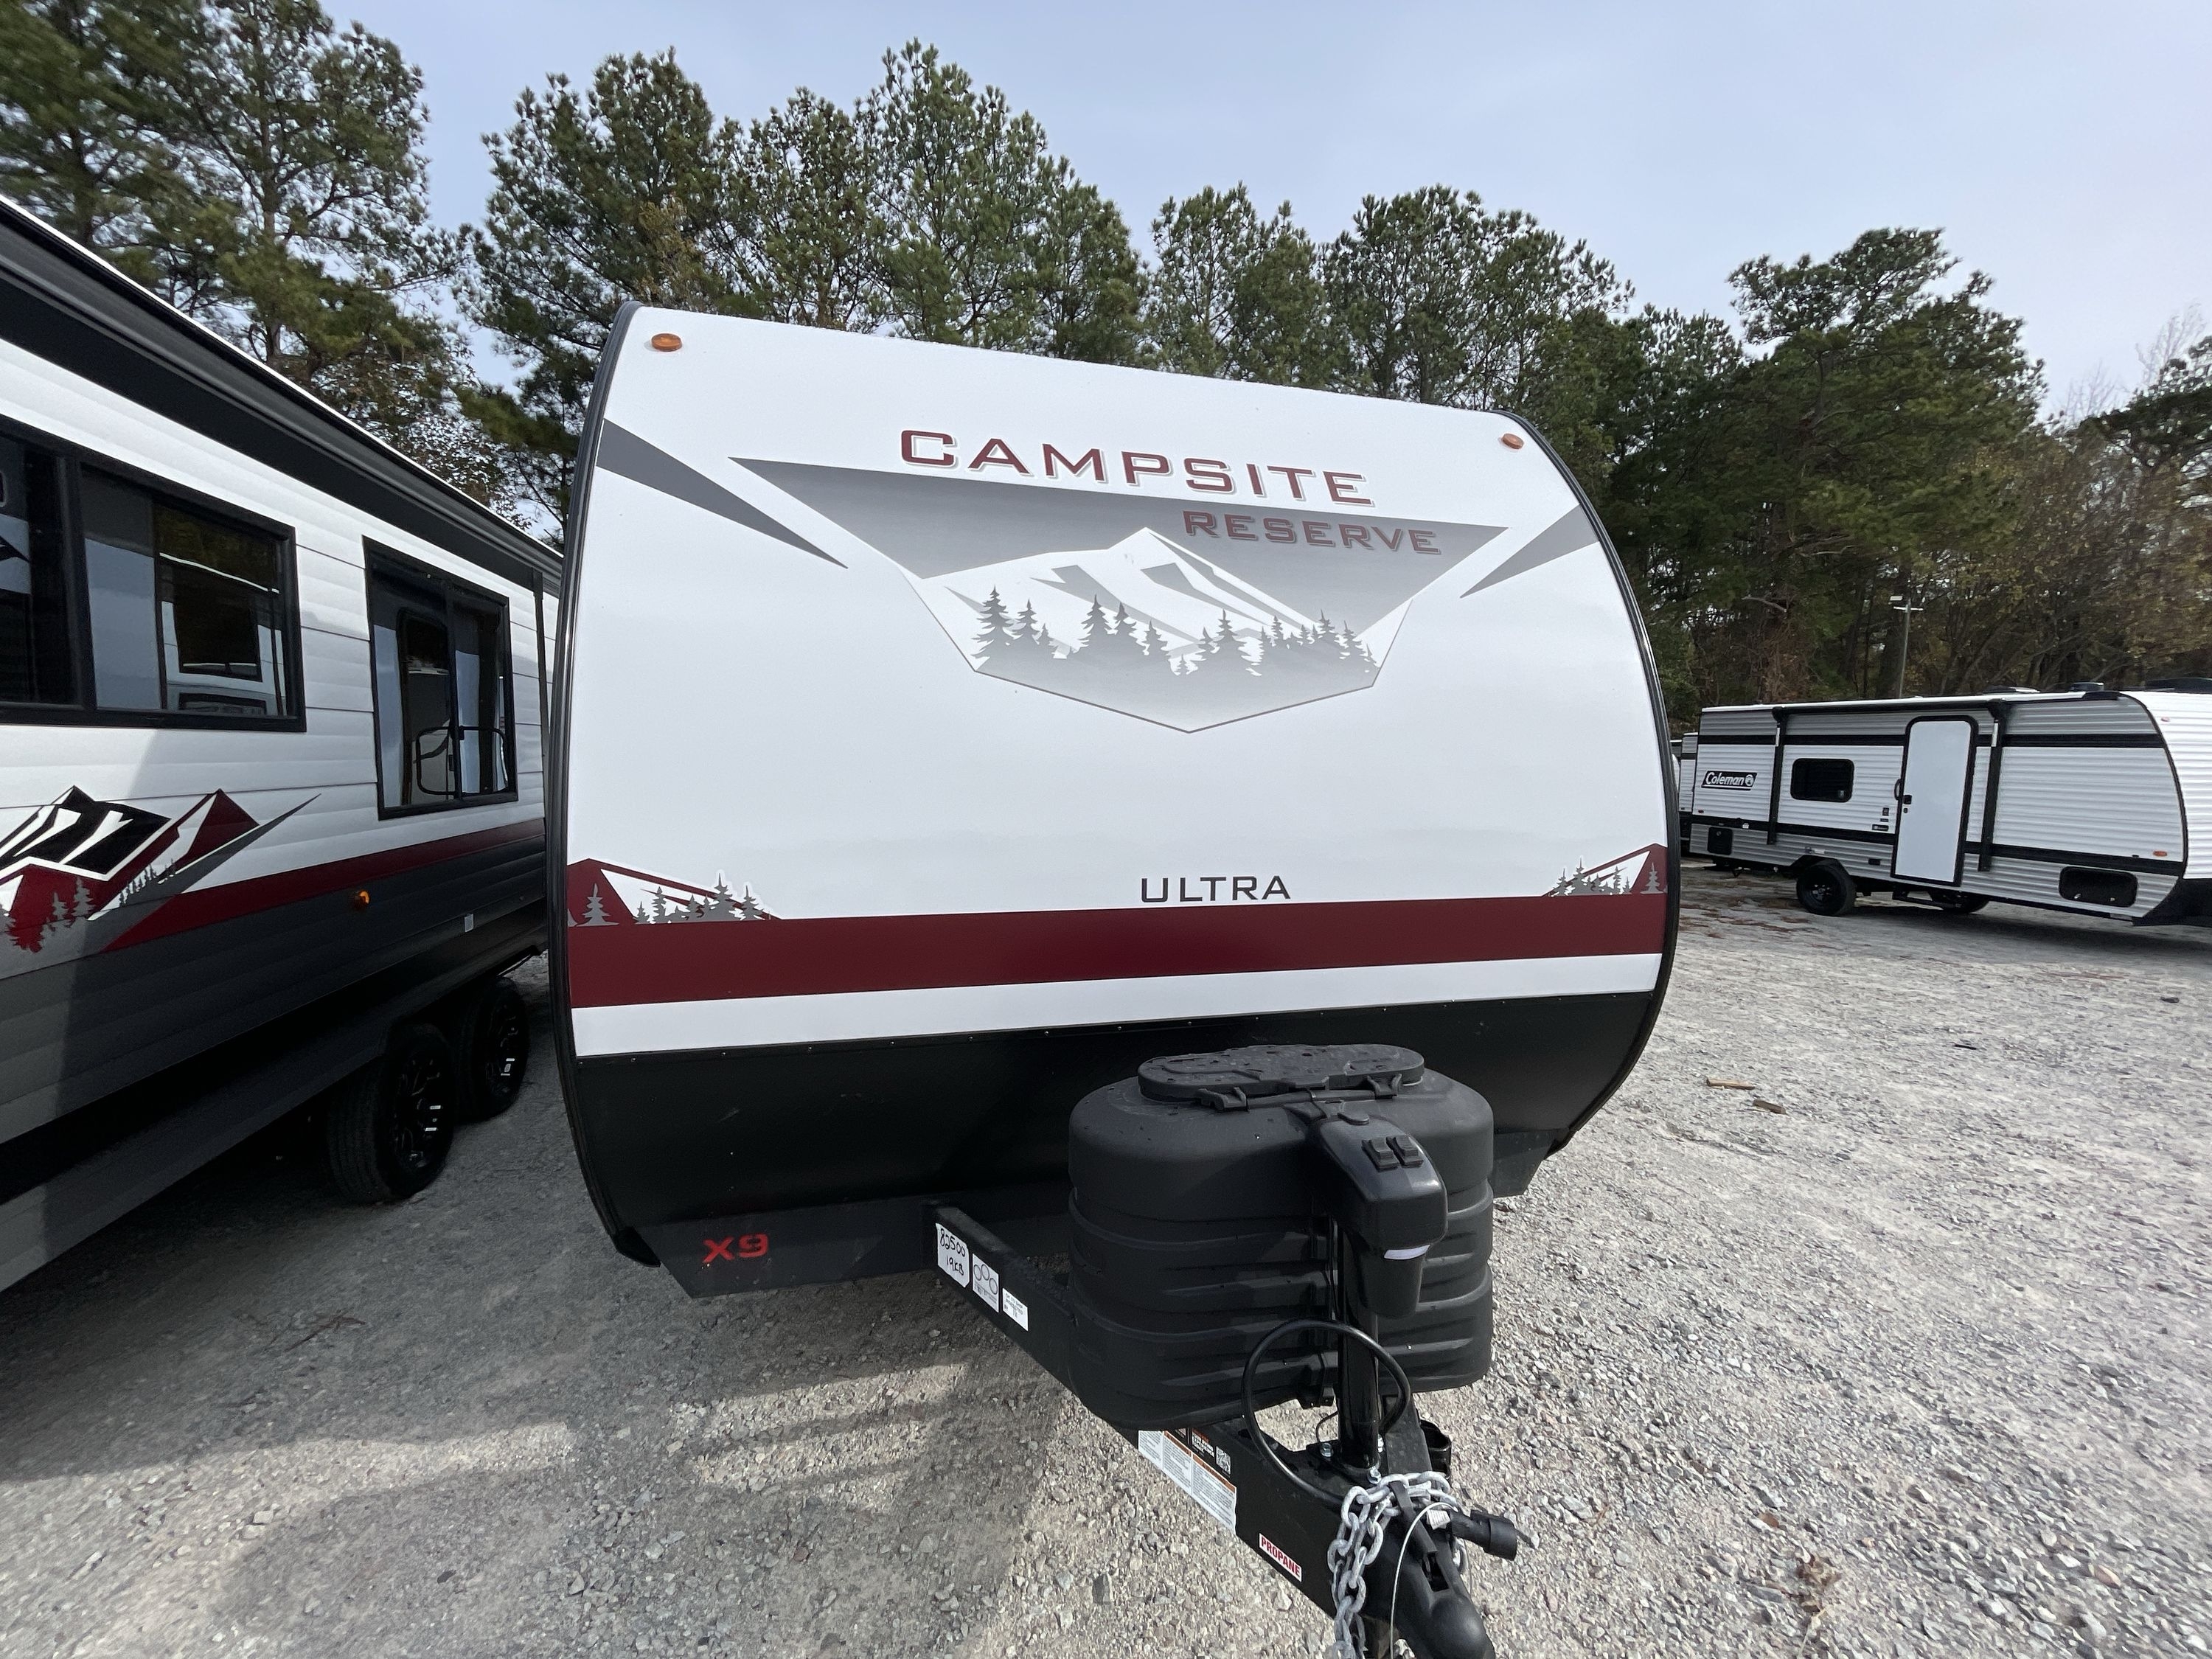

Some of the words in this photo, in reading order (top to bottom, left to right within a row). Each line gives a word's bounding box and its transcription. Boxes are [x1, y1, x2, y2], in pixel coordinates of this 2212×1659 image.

[900, 429, 1373, 507] CAMPSITE
[1182, 510, 1441, 555] RESERVE
[1705, 771, 1745, 786] Coleman
[1141, 875, 1291, 903] ULTRA
[701, 1233, 769, 1264] X9
[1260, 1535, 1301, 1578] PROPANE
